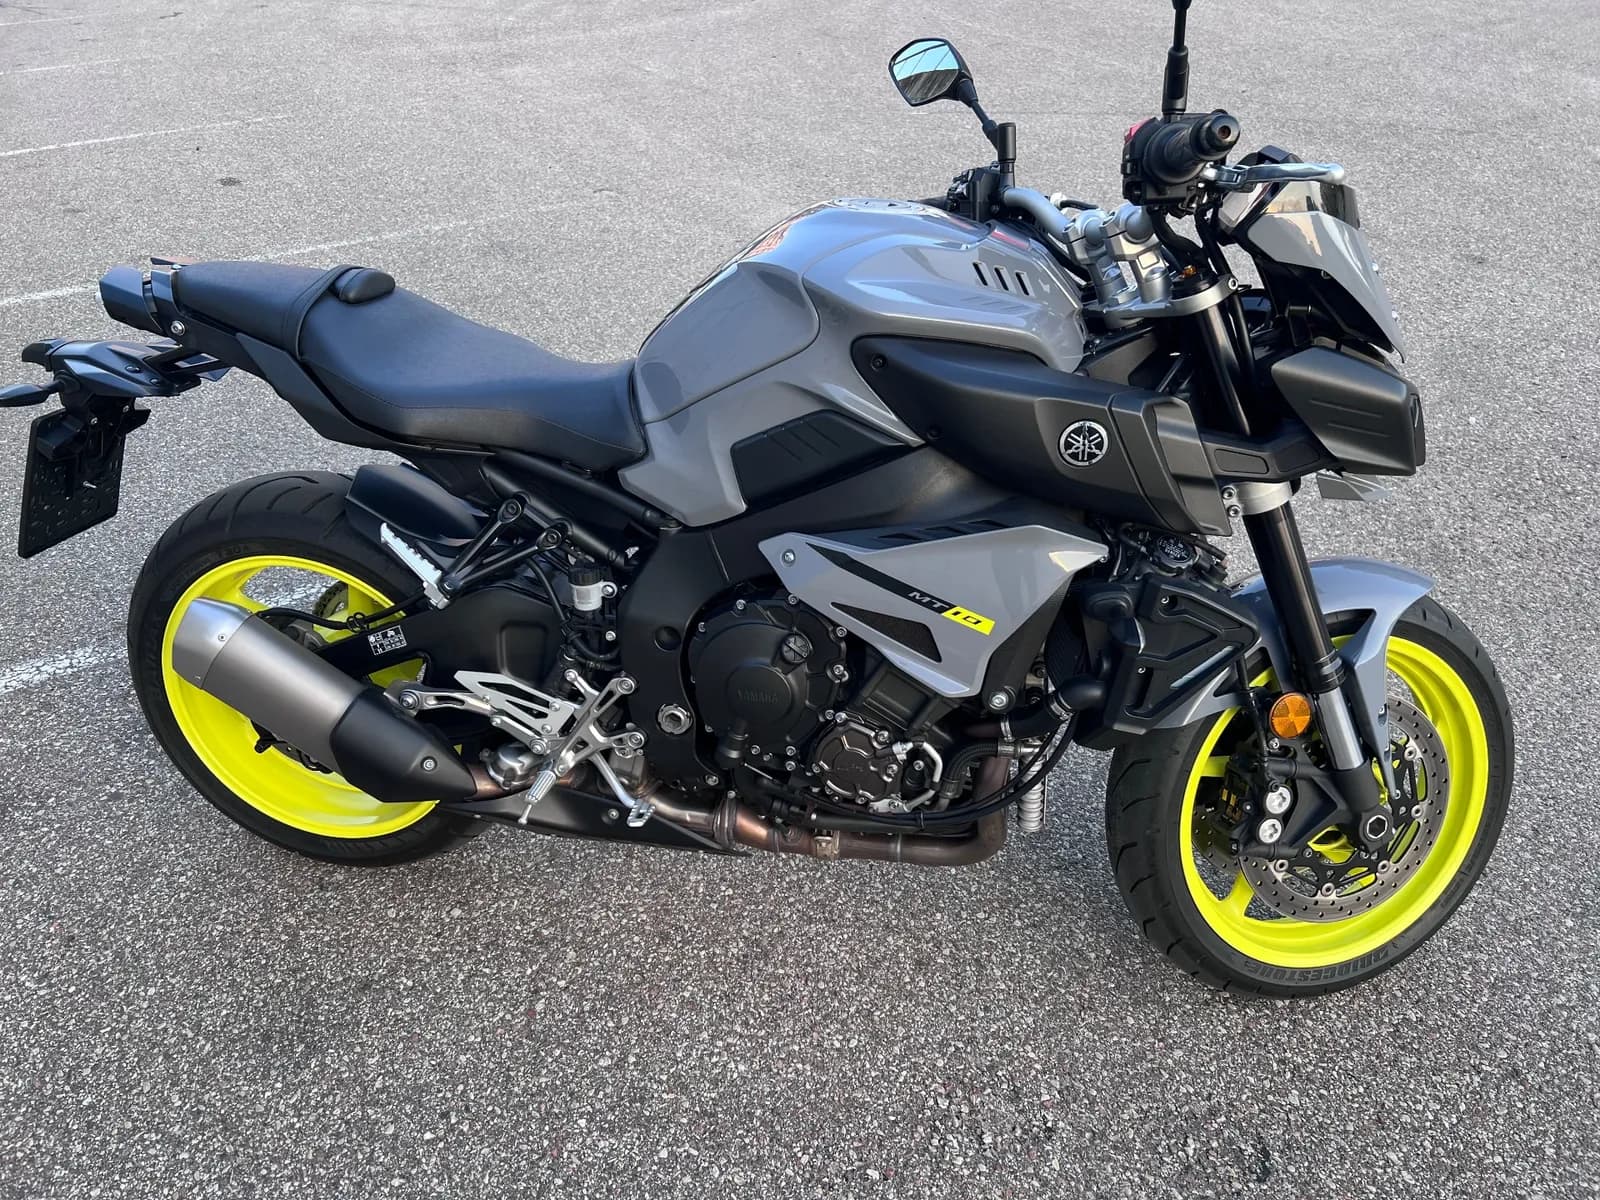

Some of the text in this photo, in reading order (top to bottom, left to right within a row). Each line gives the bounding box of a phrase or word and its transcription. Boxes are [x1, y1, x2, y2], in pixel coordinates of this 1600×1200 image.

[908, 591, 983, 625] MT 10
[736, 687, 778, 705] YAMAHA
[1244, 947, 1389, 982] BRIDGESTONE
